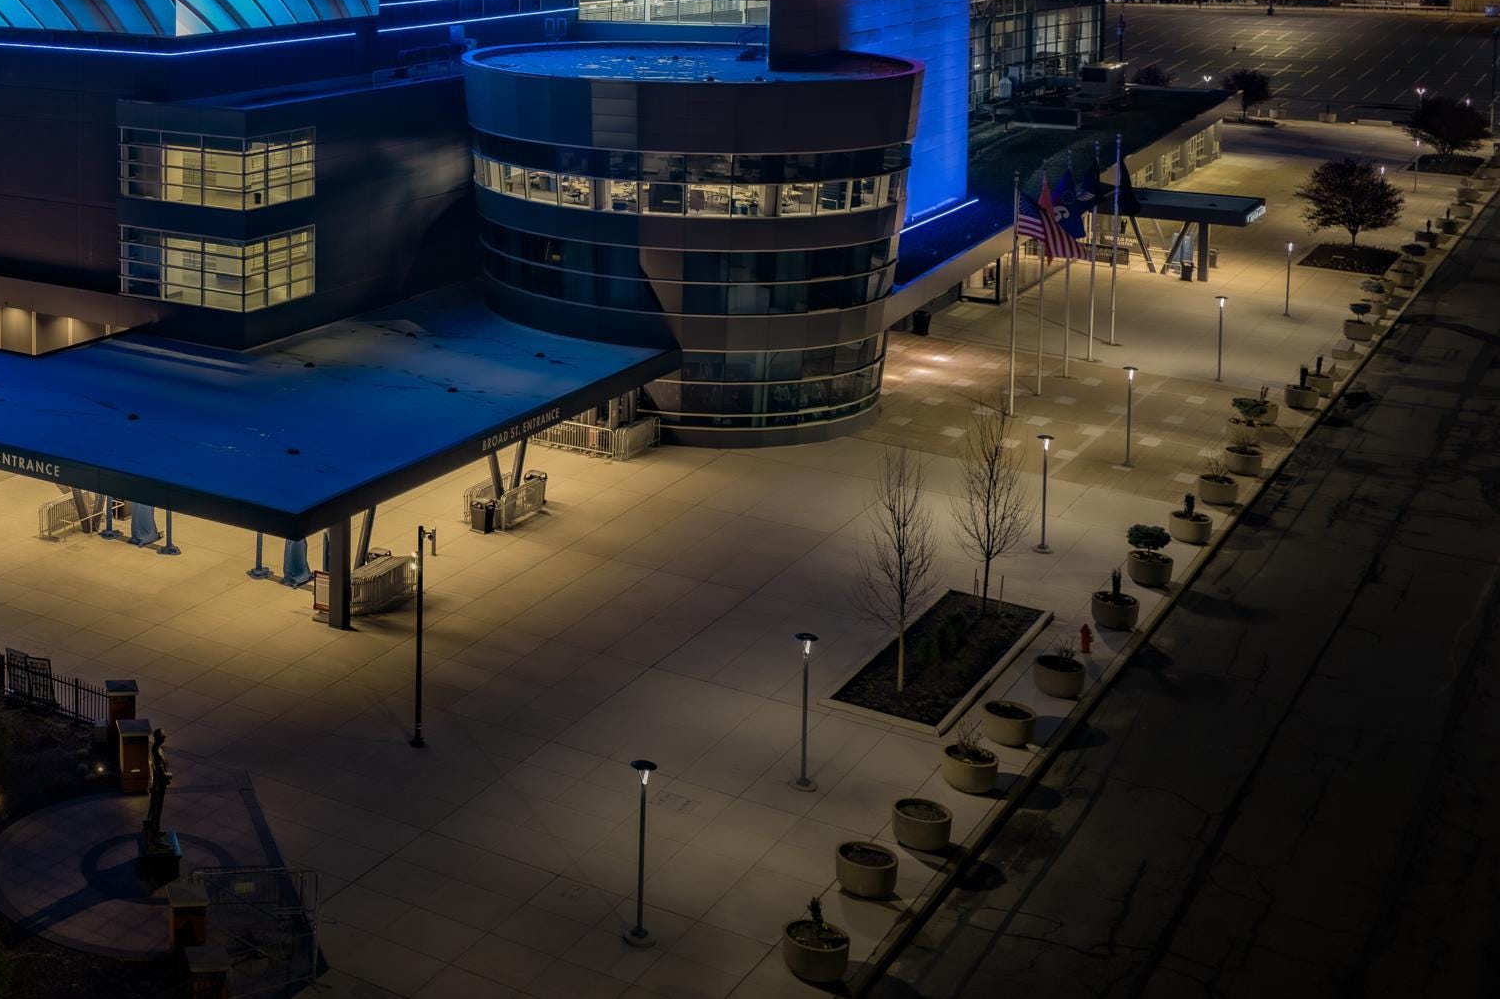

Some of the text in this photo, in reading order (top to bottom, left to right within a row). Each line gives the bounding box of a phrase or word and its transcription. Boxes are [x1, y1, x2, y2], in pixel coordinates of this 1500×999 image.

[482, 407, 560, 451] BROAD ST. ENTRANCE
